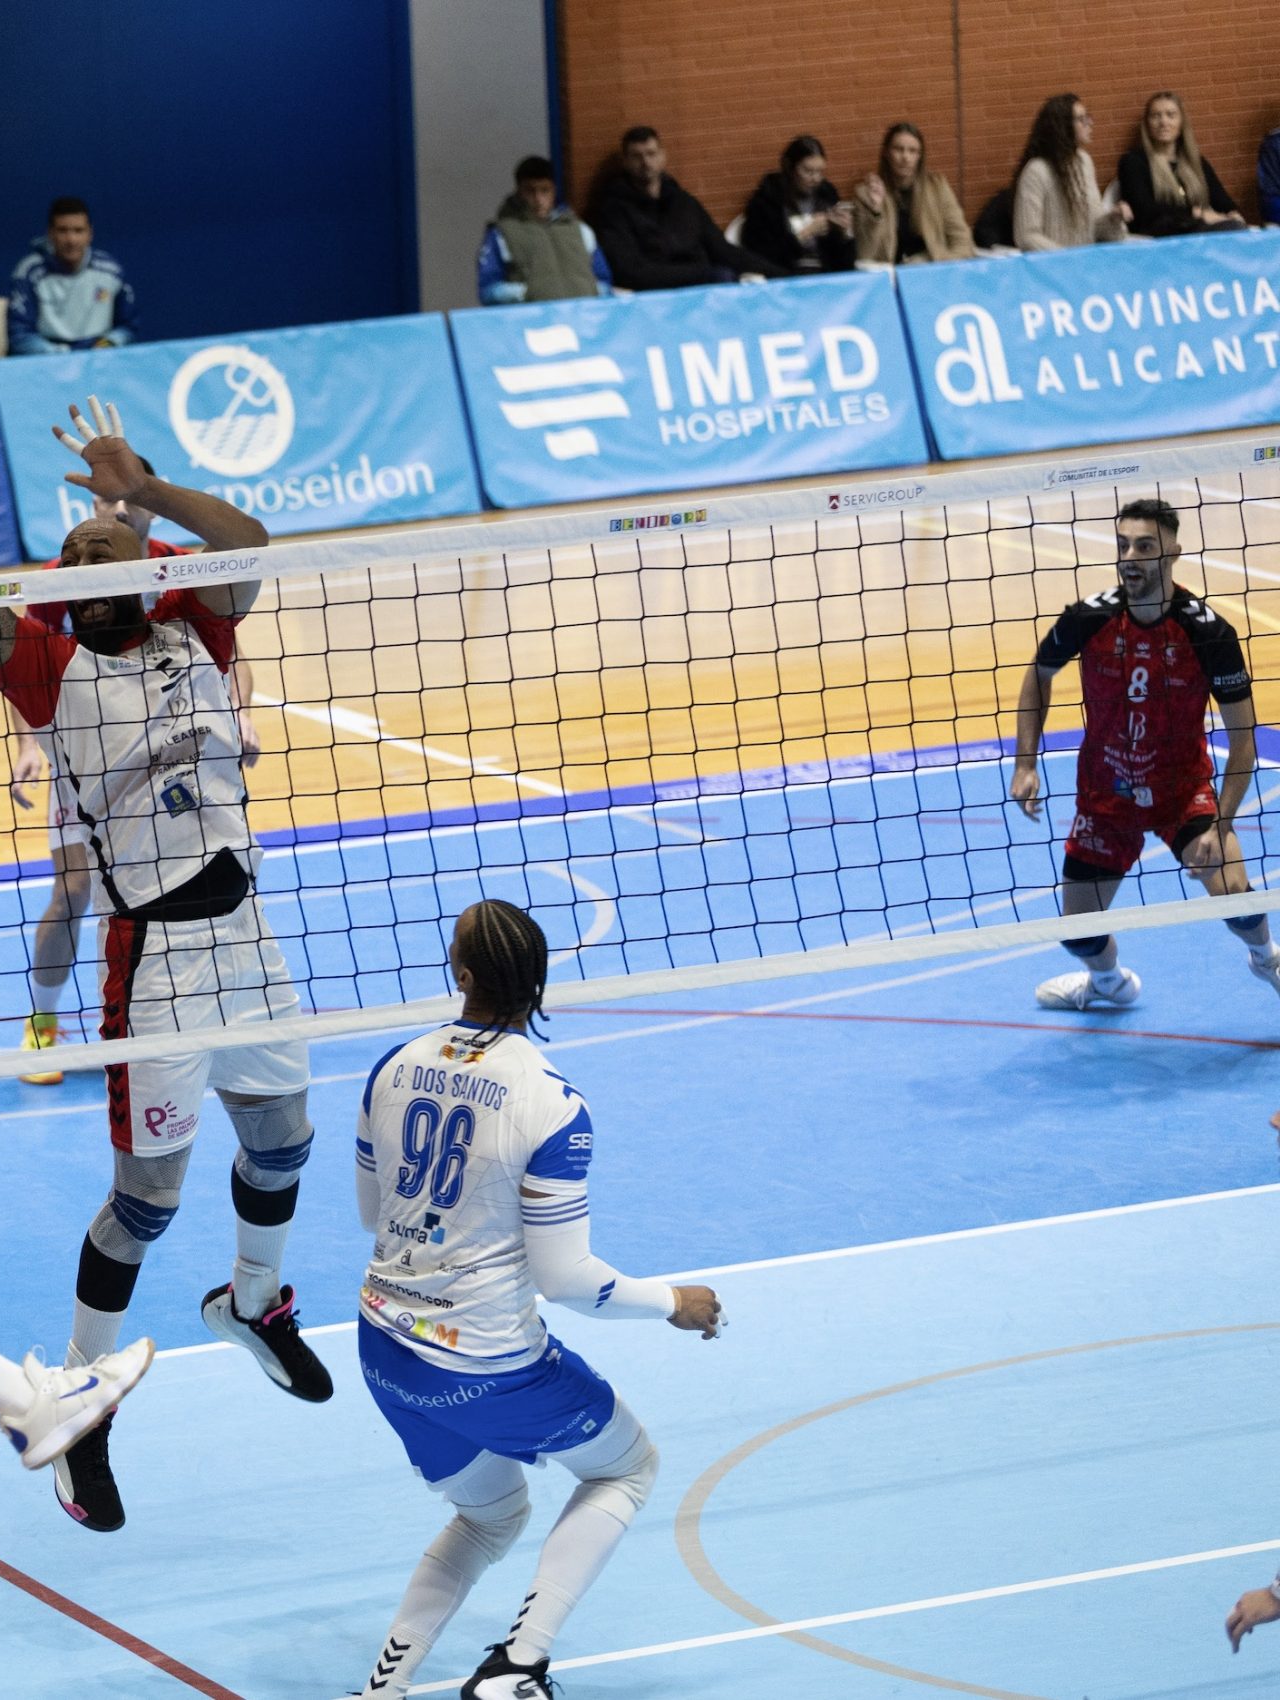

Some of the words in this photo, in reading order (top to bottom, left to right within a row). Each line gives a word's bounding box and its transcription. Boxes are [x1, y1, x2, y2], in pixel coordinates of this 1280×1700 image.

[1021, 277, 1280, 341] PROVINCIA
[645, 326, 880, 411] IMED
[657, 392, 891, 446] HOSPITALES
[58, 453, 436, 536] hposeidon
[843, 487, 924, 507] SERVIGROUP
[171, 557, 257, 579] SERVIGROUP
[1127, 666, 1150, 704] 8
[165, 725, 213, 747] LEADER
[412, 1065, 447, 1095] DOS
[451, 1073, 508, 1111] SANTOS
[394, 1097, 476, 1209] 96
[387, 1220, 428, 1245] suma
